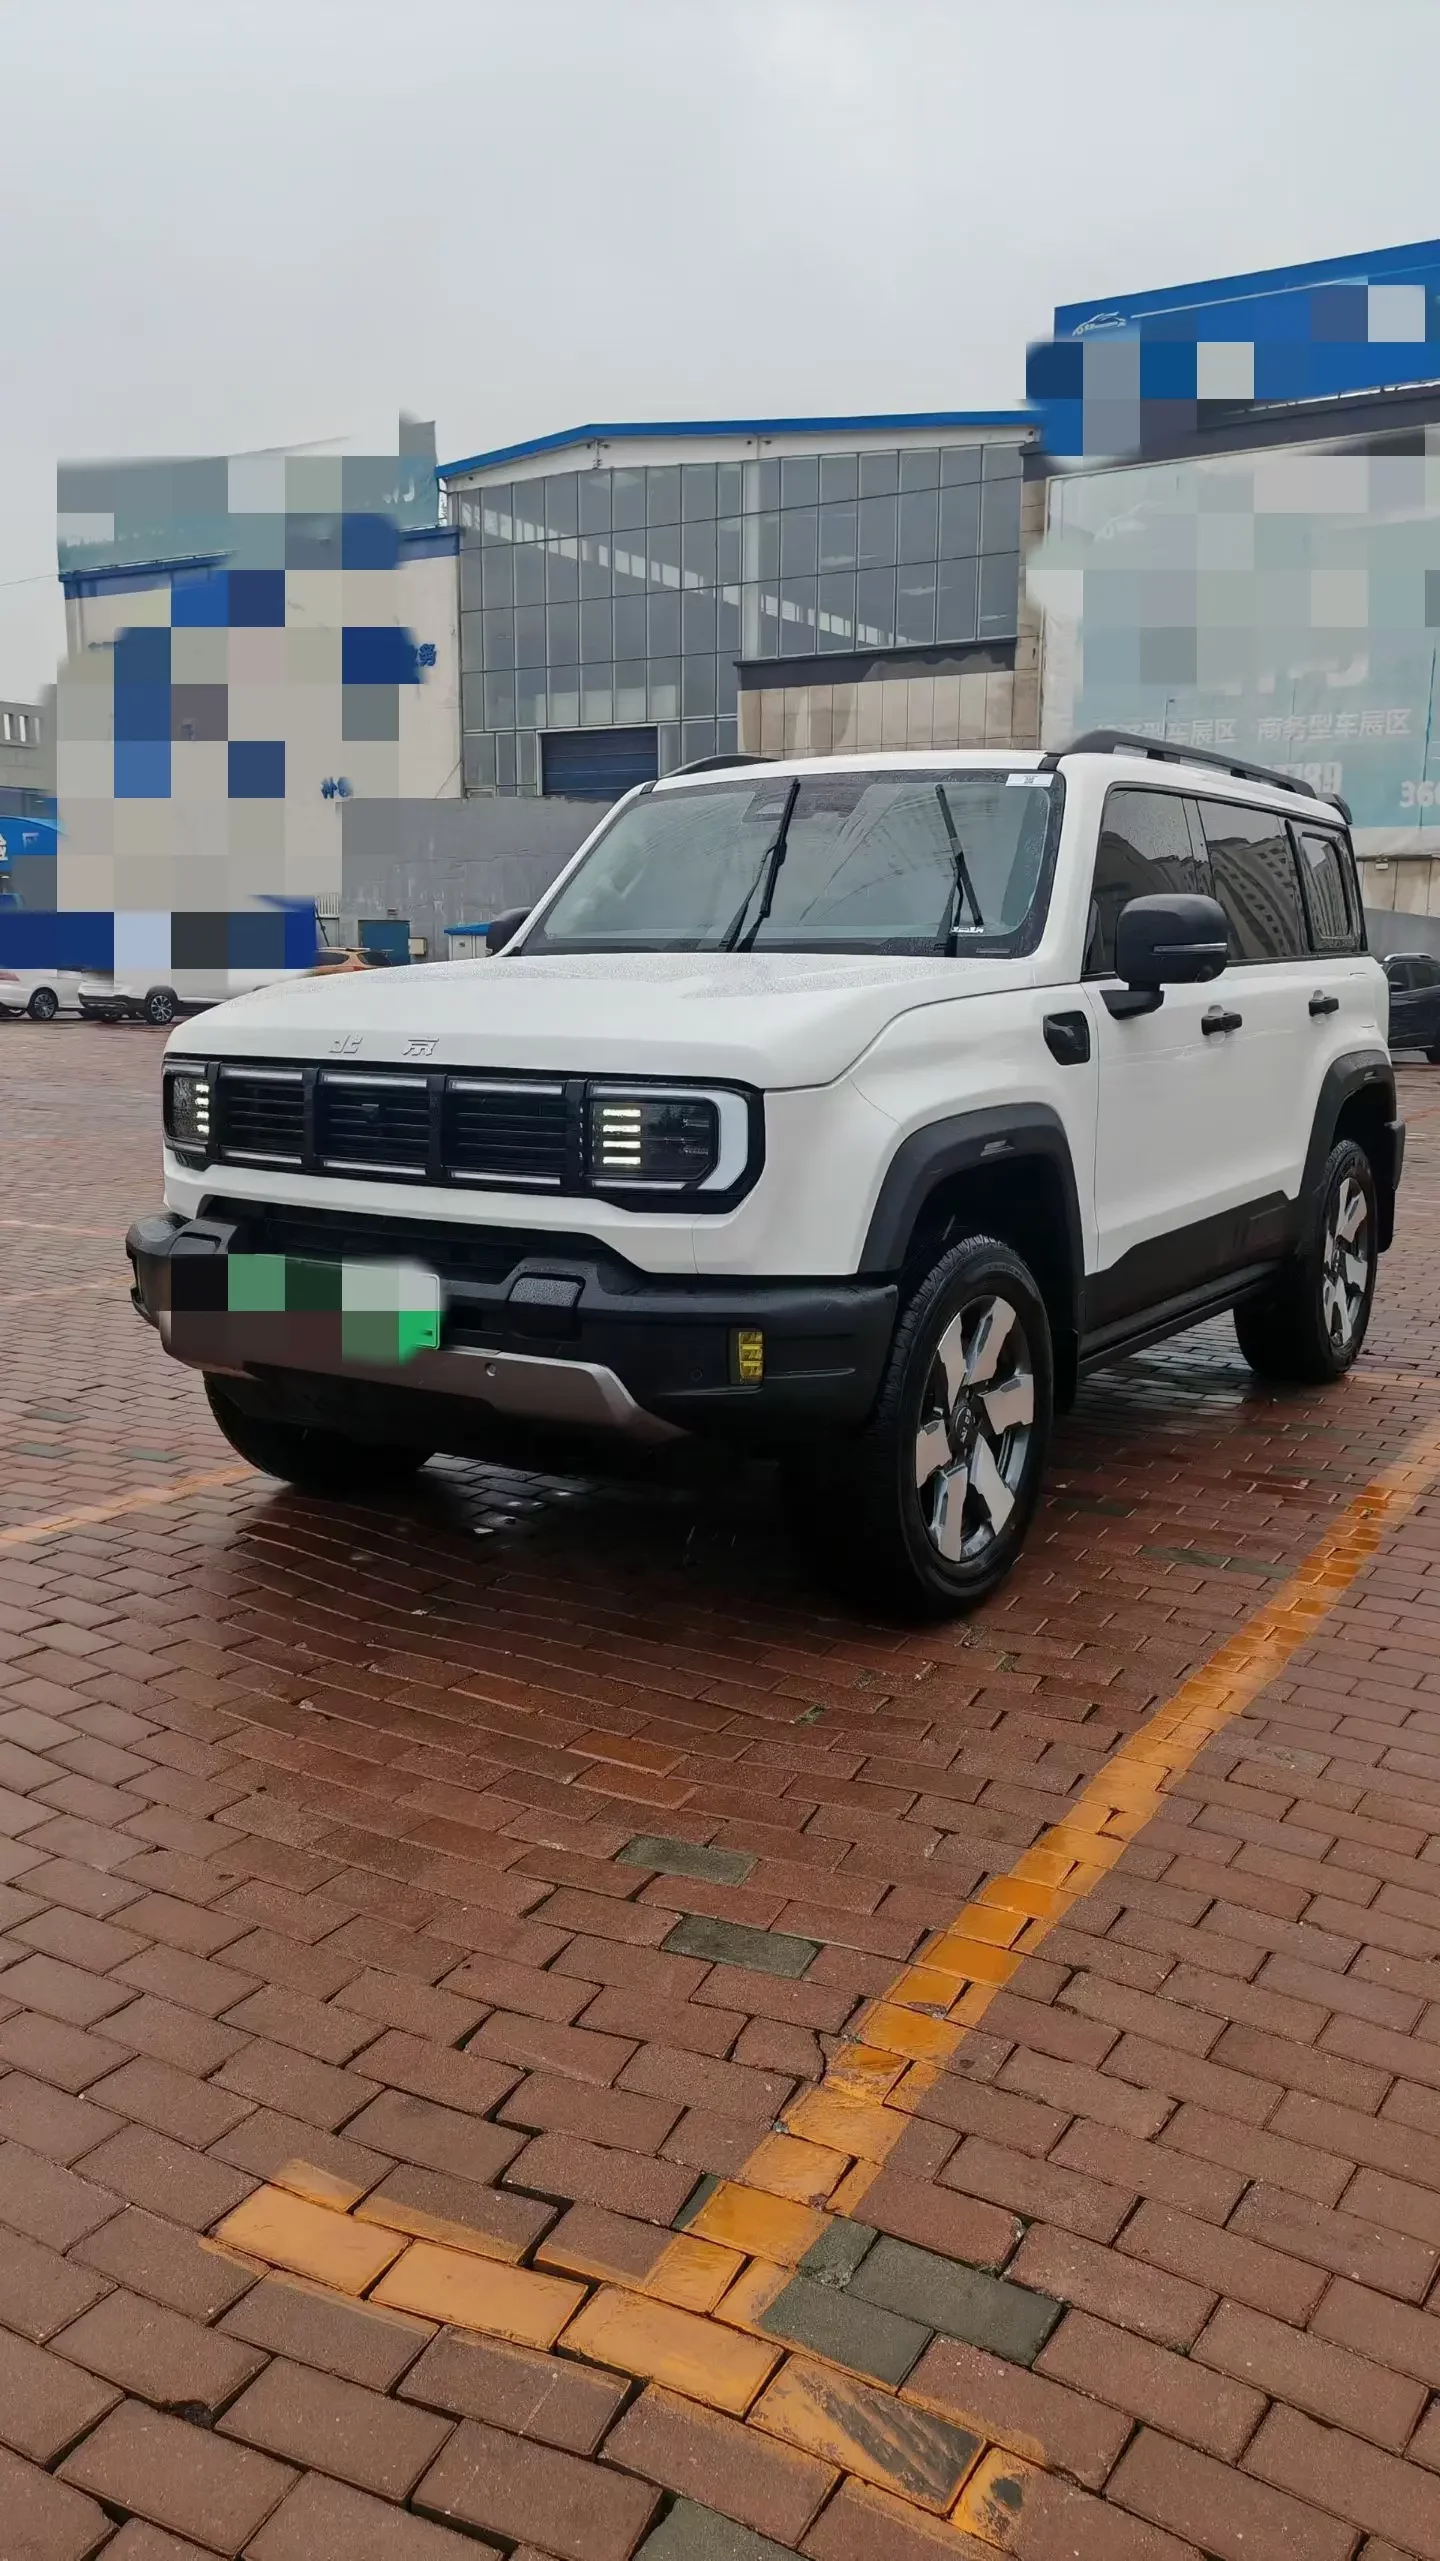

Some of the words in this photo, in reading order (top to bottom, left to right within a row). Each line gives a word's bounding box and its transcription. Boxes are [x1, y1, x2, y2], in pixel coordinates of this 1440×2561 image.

[1257, 708, 1412, 743] 商务型车展区
[1400, 779, 1440, 808] 36
